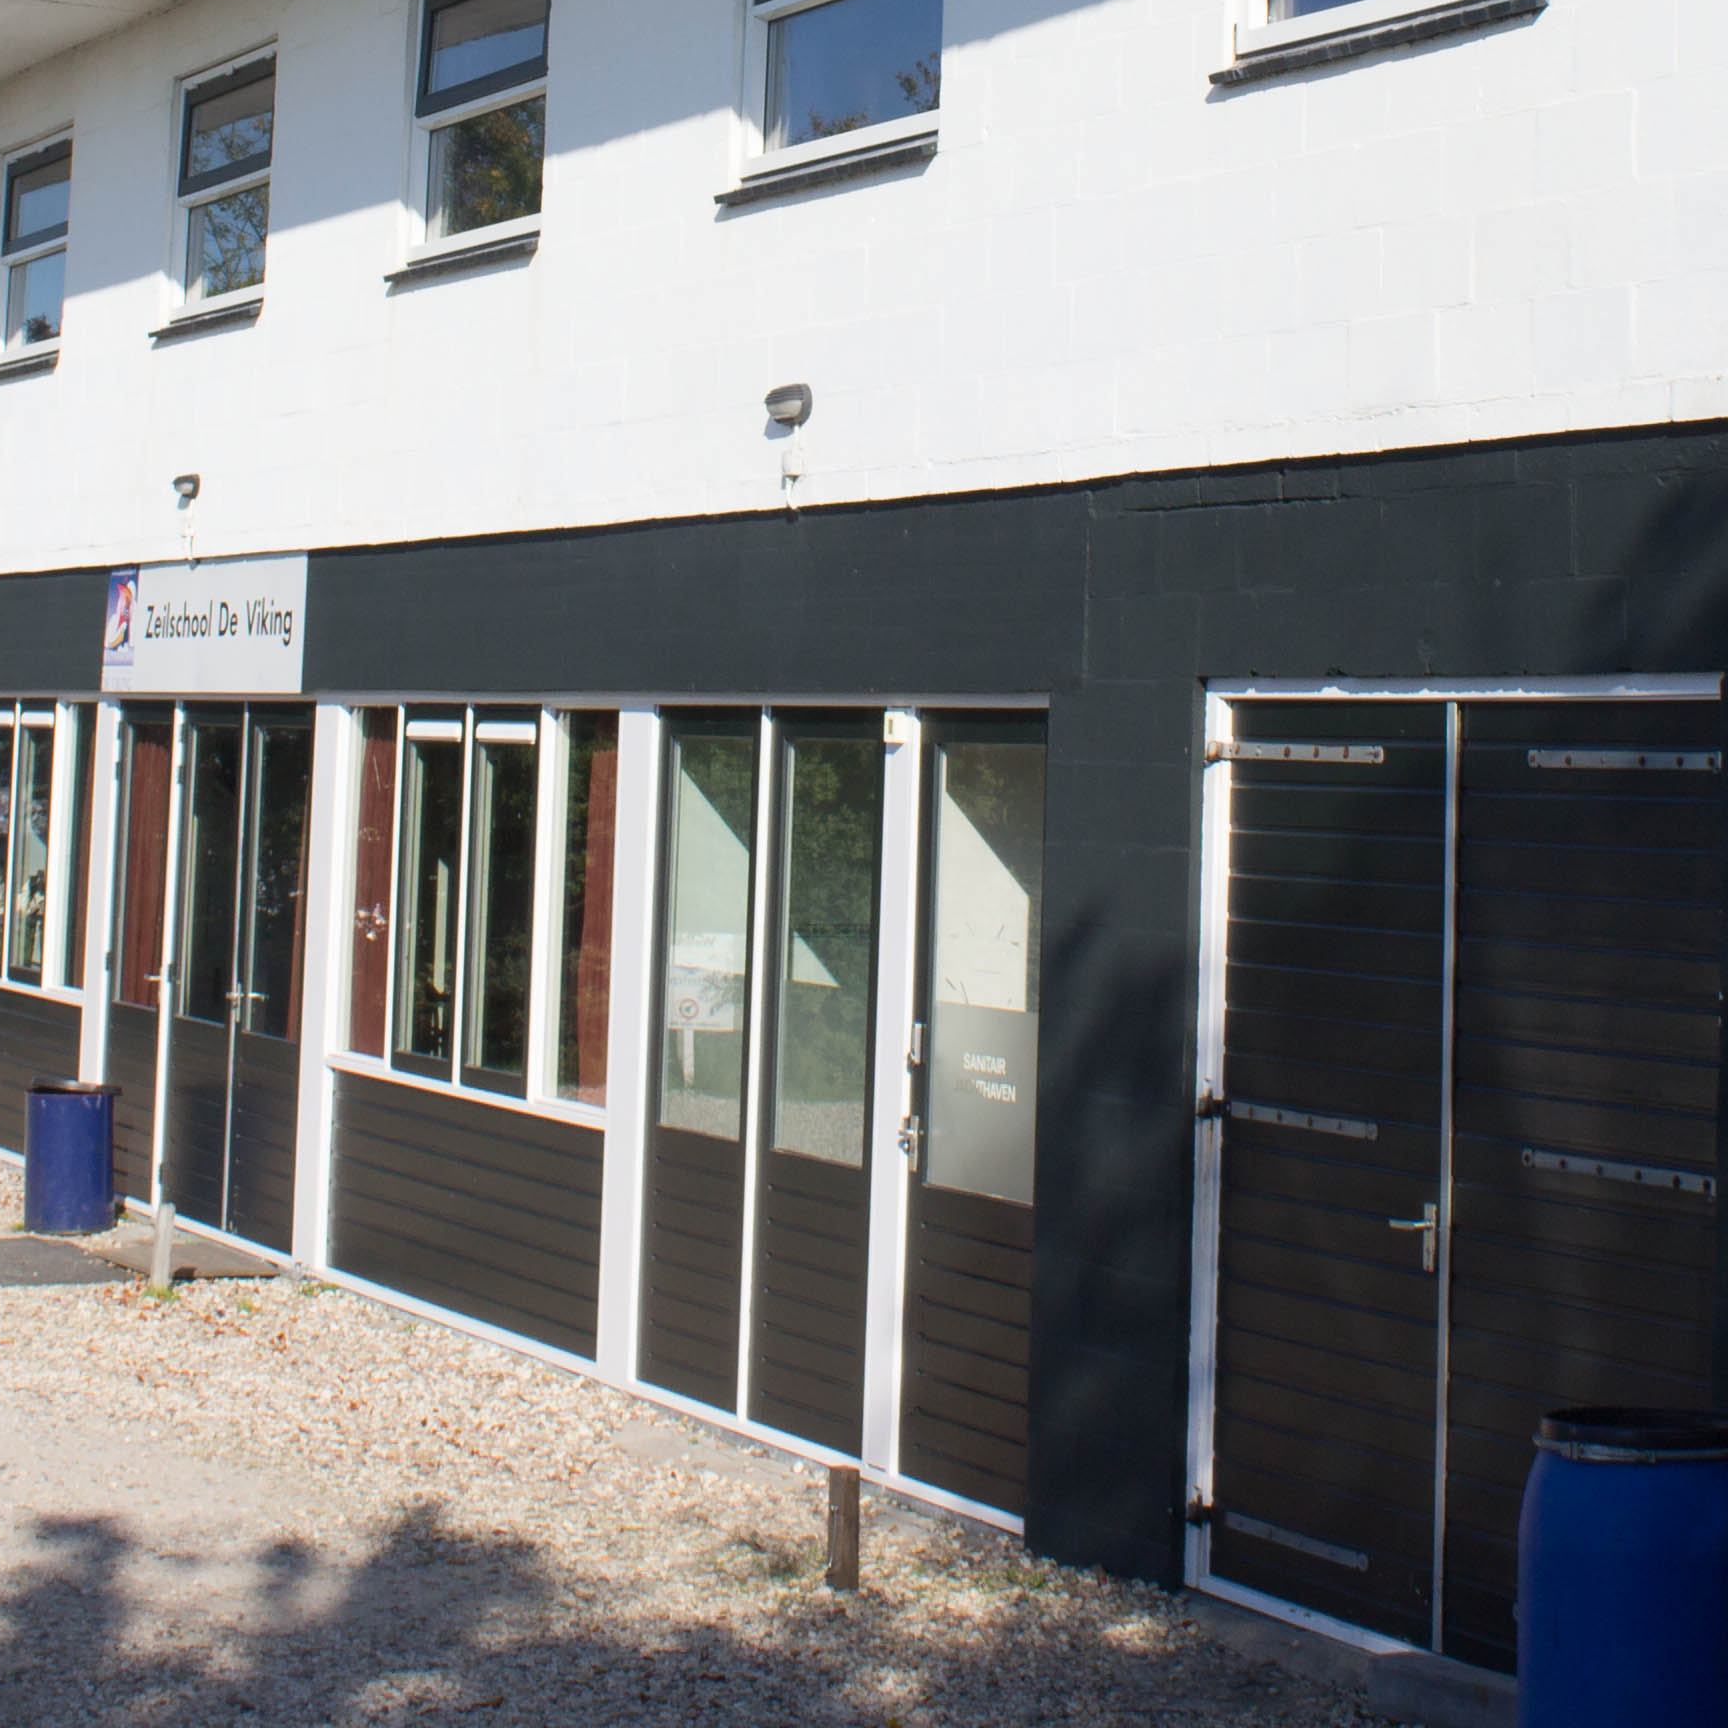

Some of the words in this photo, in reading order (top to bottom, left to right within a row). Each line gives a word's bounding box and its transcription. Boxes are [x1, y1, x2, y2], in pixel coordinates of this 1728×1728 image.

[145, 600, 213, 639] Zeilschool
[218, 601, 238, 638] De
[247, 597, 293, 646] Viking
[962, 1051, 1007, 1076] SANITAIR
